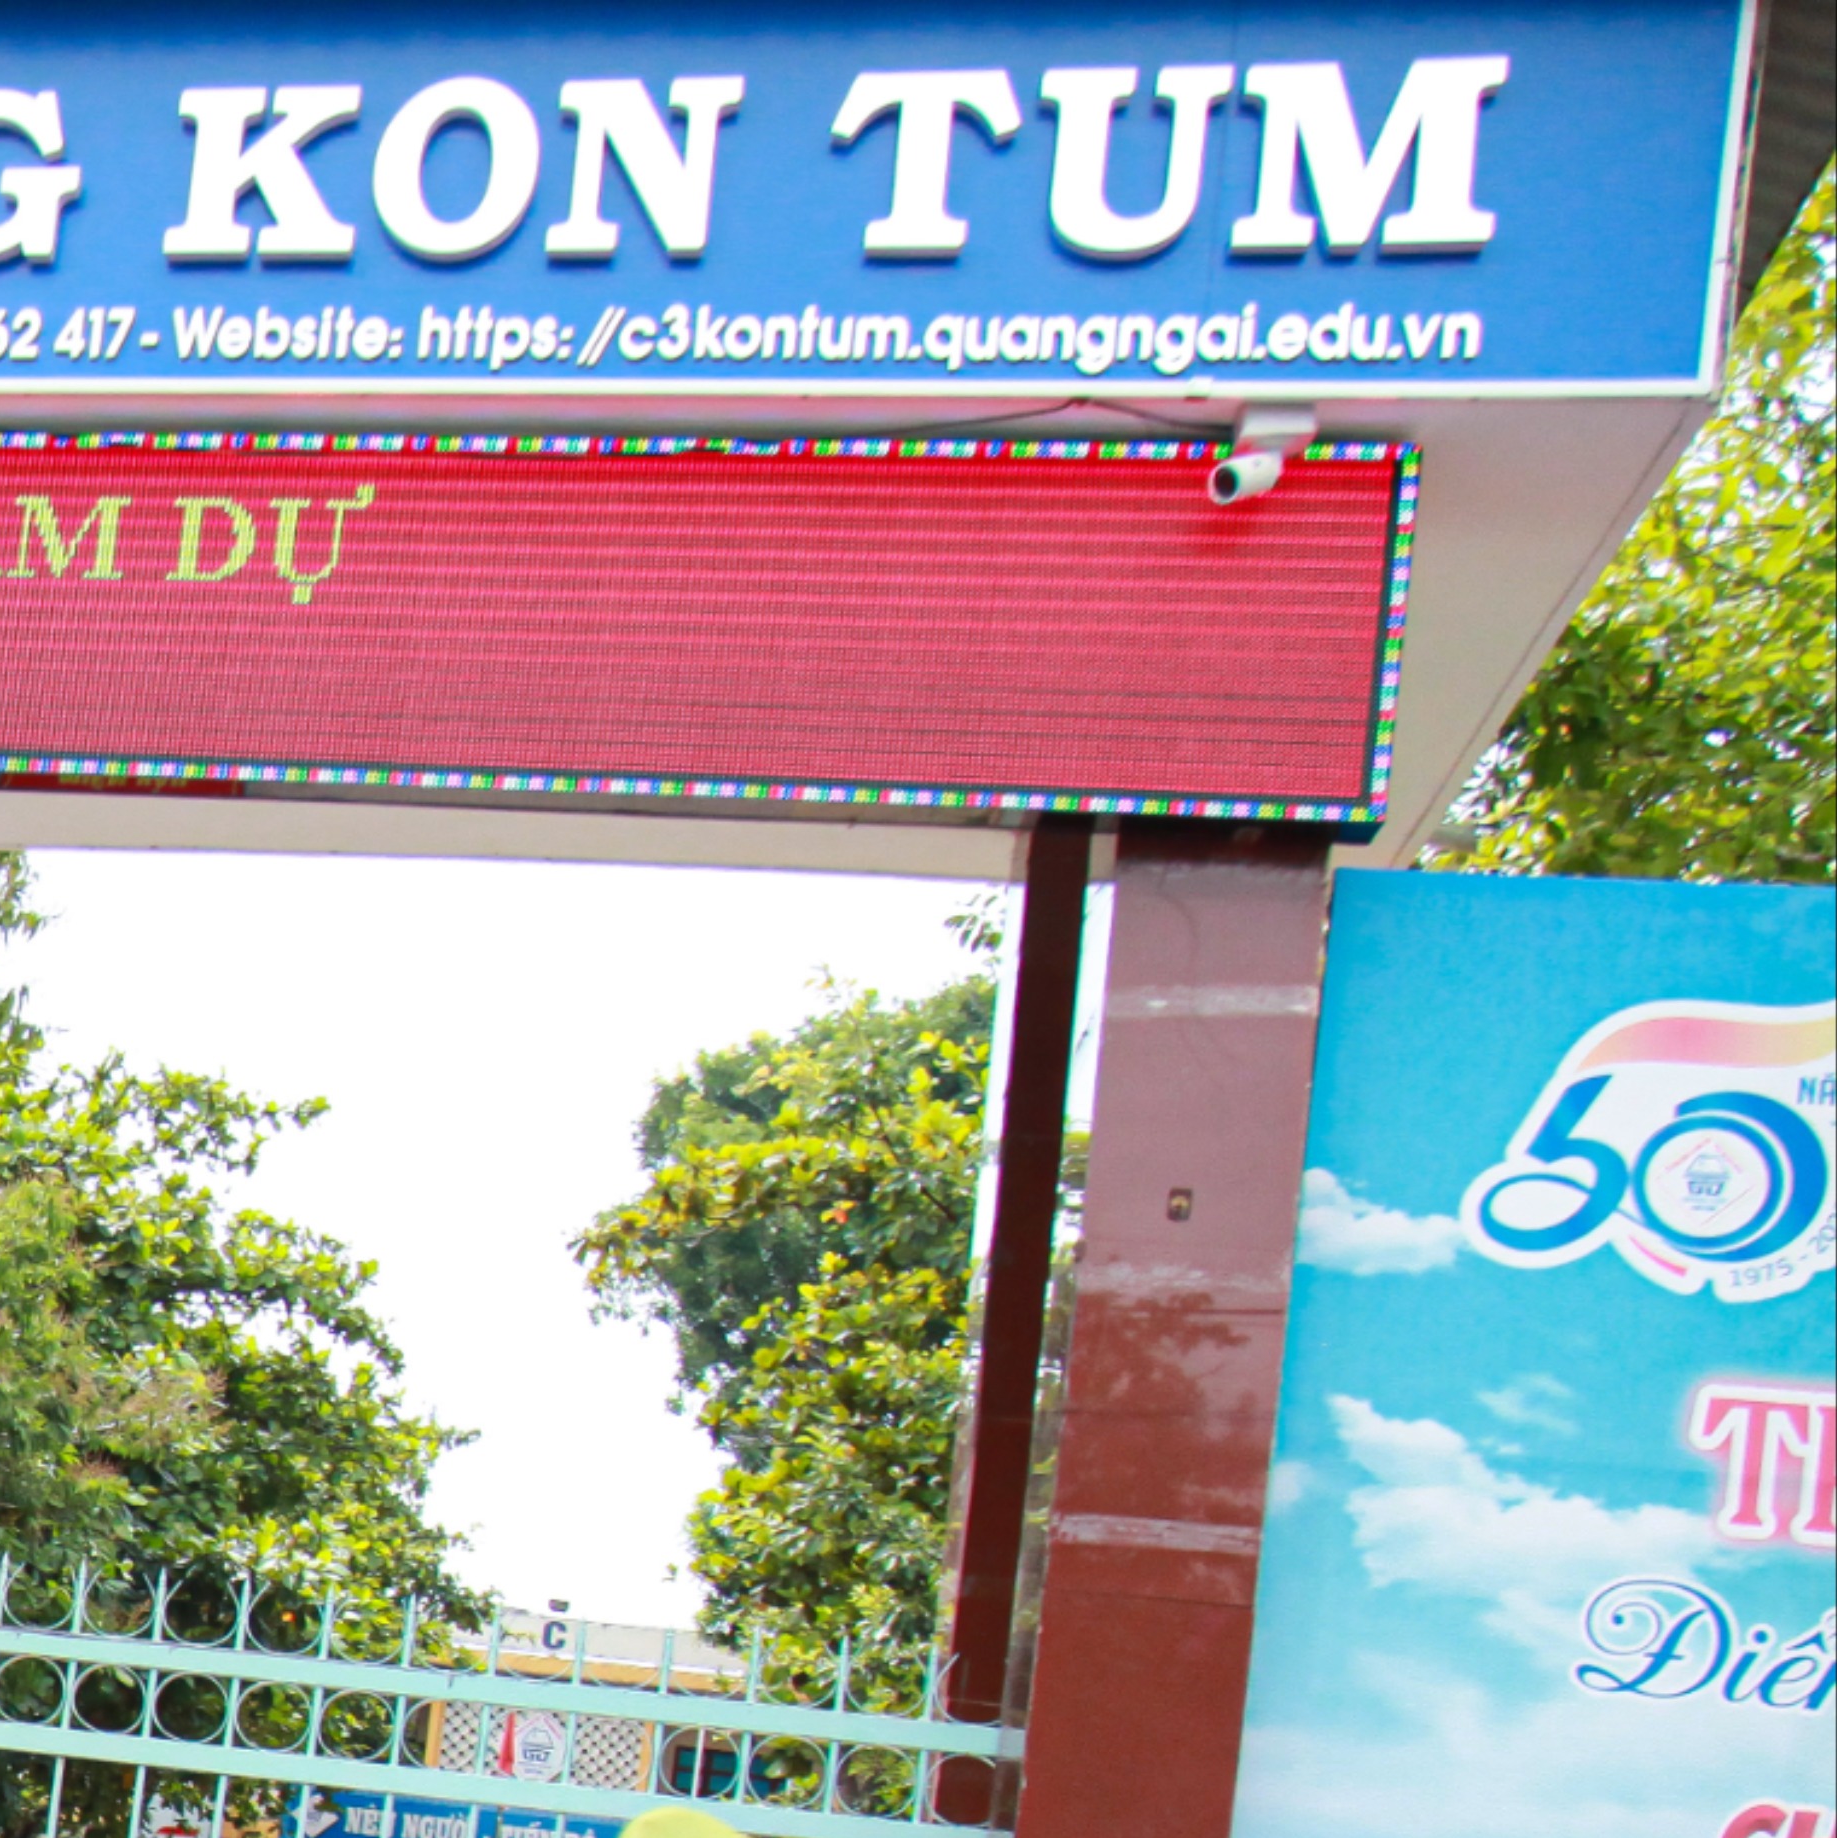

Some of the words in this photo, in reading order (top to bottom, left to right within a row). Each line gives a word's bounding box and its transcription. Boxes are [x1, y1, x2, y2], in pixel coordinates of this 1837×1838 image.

[164, 75, 745, 265] KON
[829, 54, 1509, 260] TUM
[54, 308, 136, 360] 417
[174, 306, 405, 361] Website:
[166, 483, 375, 603] DỰ
[1477, 1073, 1829, 1264] 50
[1730, 1257, 1795, 1287] 1975
[542, 1619, 567, 1651] C
